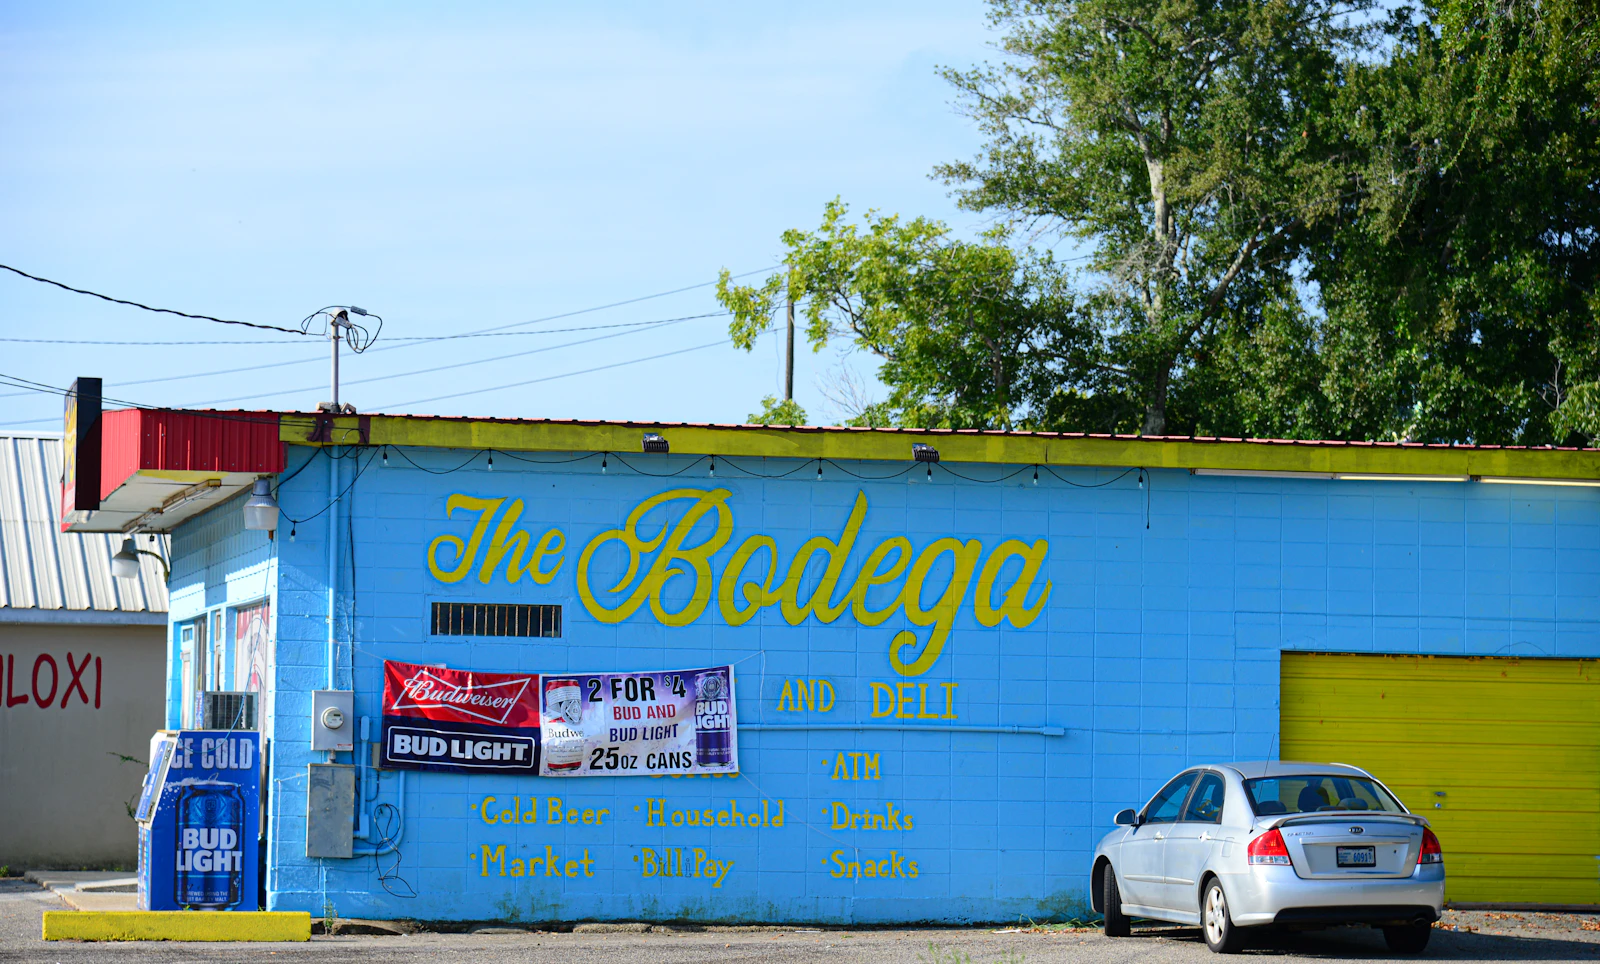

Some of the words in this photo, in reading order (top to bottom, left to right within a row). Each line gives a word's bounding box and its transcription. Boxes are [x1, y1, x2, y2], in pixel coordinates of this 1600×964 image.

[427, 493, 566, 585] The
[576, 488, 1053, 678] Bodega
[403, 678, 516, 709] Budweiser
[588, 679, 603, 702] 2
[610, 677, 656, 702] FOR
[776, 679, 836, 713] AND
[869, 682, 959, 719] DELI
[613, 705, 642, 721] BUD
[647, 703, 676, 719] AND
[696, 700, 728, 716] BUD
[393, 733, 448, 757] BUD
[450, 739, 529, 761] LIGHT
[609, 727, 637, 743] BUD
[642, 723, 679, 741] LIGHT
[201, 737, 253, 769] COLD
[646, 751, 692, 769] CANS
[831, 752, 881, 781] ATM
[481, 796, 537, 825] Cold
[547, 797, 610, 826] Beer
[646, 798, 785, 828] Household
[831, 801, 914, 831] Drinks
[182, 828, 238, 850] BUD
[176, 849, 243, 873] LIGHT
[480, 844, 595, 878] Market
[693, 847, 735, 888] Pay
[830, 849, 919, 879] Snacks
